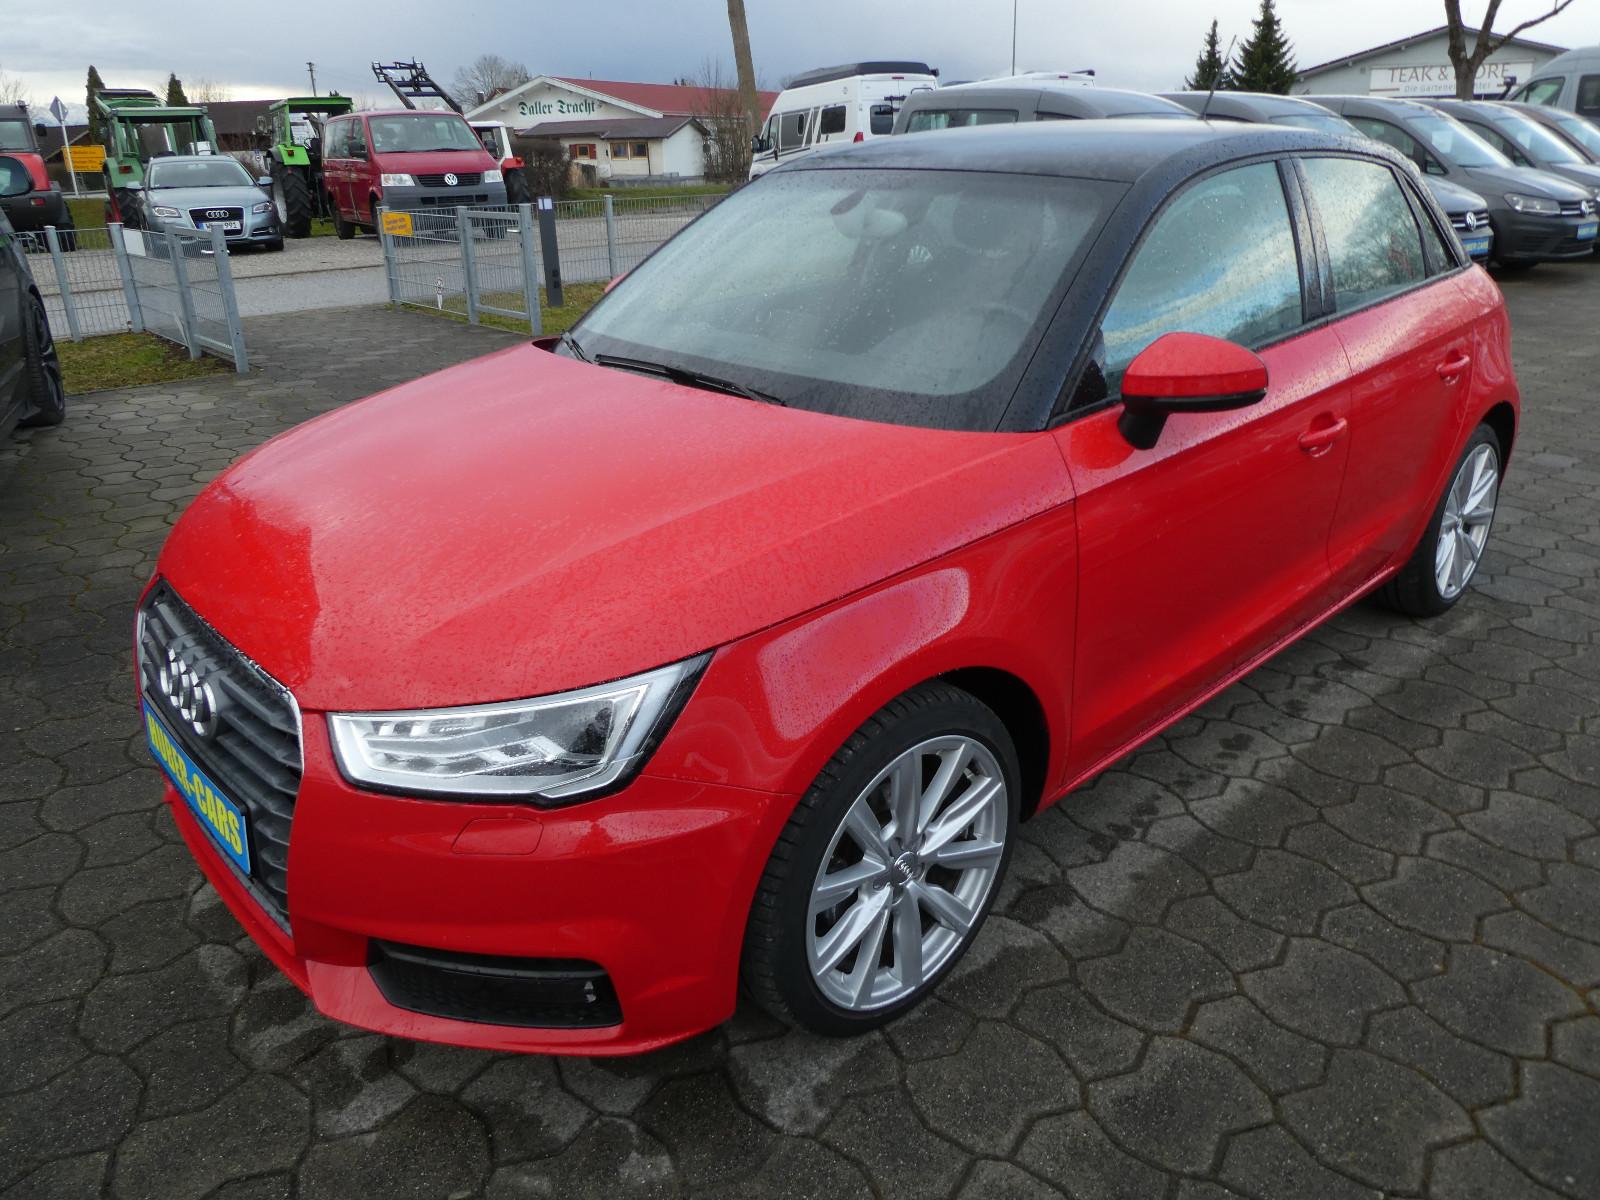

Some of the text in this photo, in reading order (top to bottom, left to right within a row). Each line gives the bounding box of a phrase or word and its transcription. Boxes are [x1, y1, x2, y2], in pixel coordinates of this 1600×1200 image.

[1388, 63, 1511, 83] TEAK & ORE
[518, 99, 596, 116] Daller Tracht
[146, 711, 243, 856] HUBER-CARS
